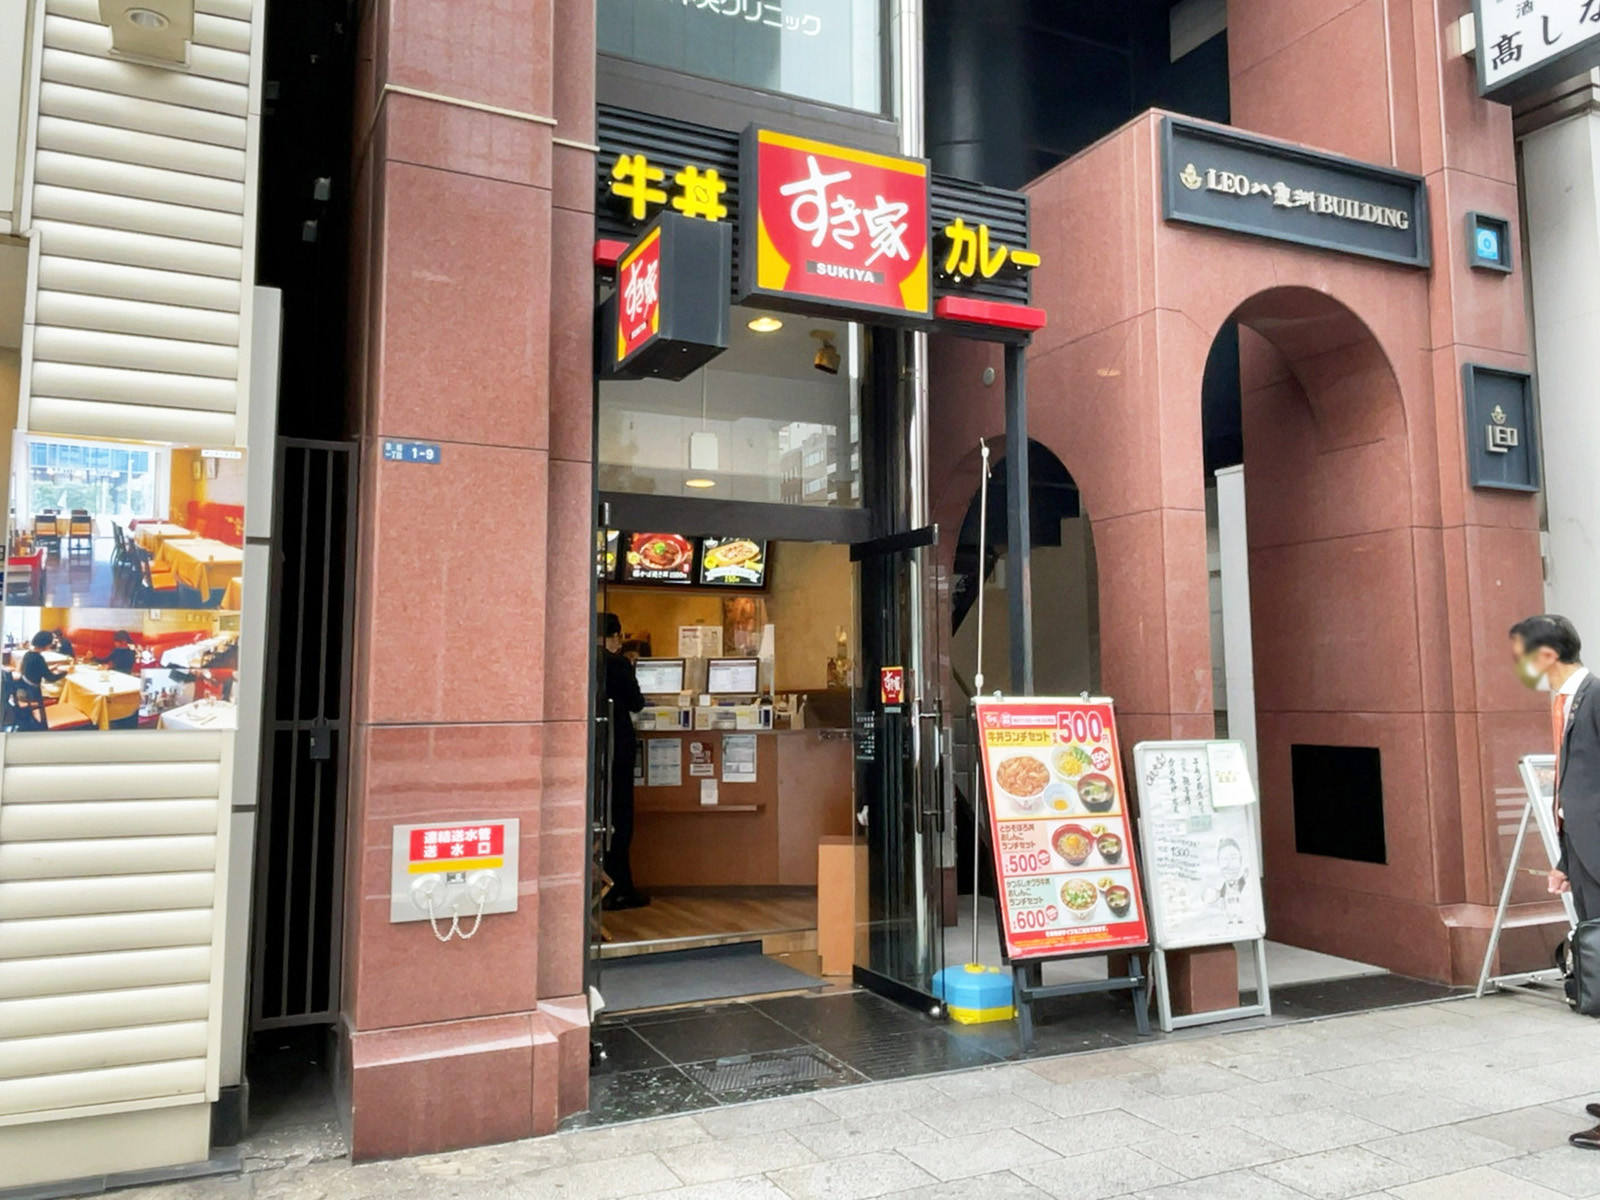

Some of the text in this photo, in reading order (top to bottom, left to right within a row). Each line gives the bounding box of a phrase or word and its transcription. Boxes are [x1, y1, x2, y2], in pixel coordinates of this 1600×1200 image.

[611, 154, 727, 221] 牛丼
[779, 155, 911, 266] すき家
[945, 217, 1041, 278] カレー
[816, 262, 876, 283] SUKIYA
[1486, 424, 1518, 453] LEO
[411, 447, 434, 460] 1-9
[987, 731, 1051, 742] 牛丼ランチセット
[1056, 711, 1102, 744] 500
[1002, 841, 1036, 850] ランチセット
[1009, 854, 1038, 873] 500
[1009, 896, 1044, 907] ランチセット
[1016, 909, 1046, 930] 600
